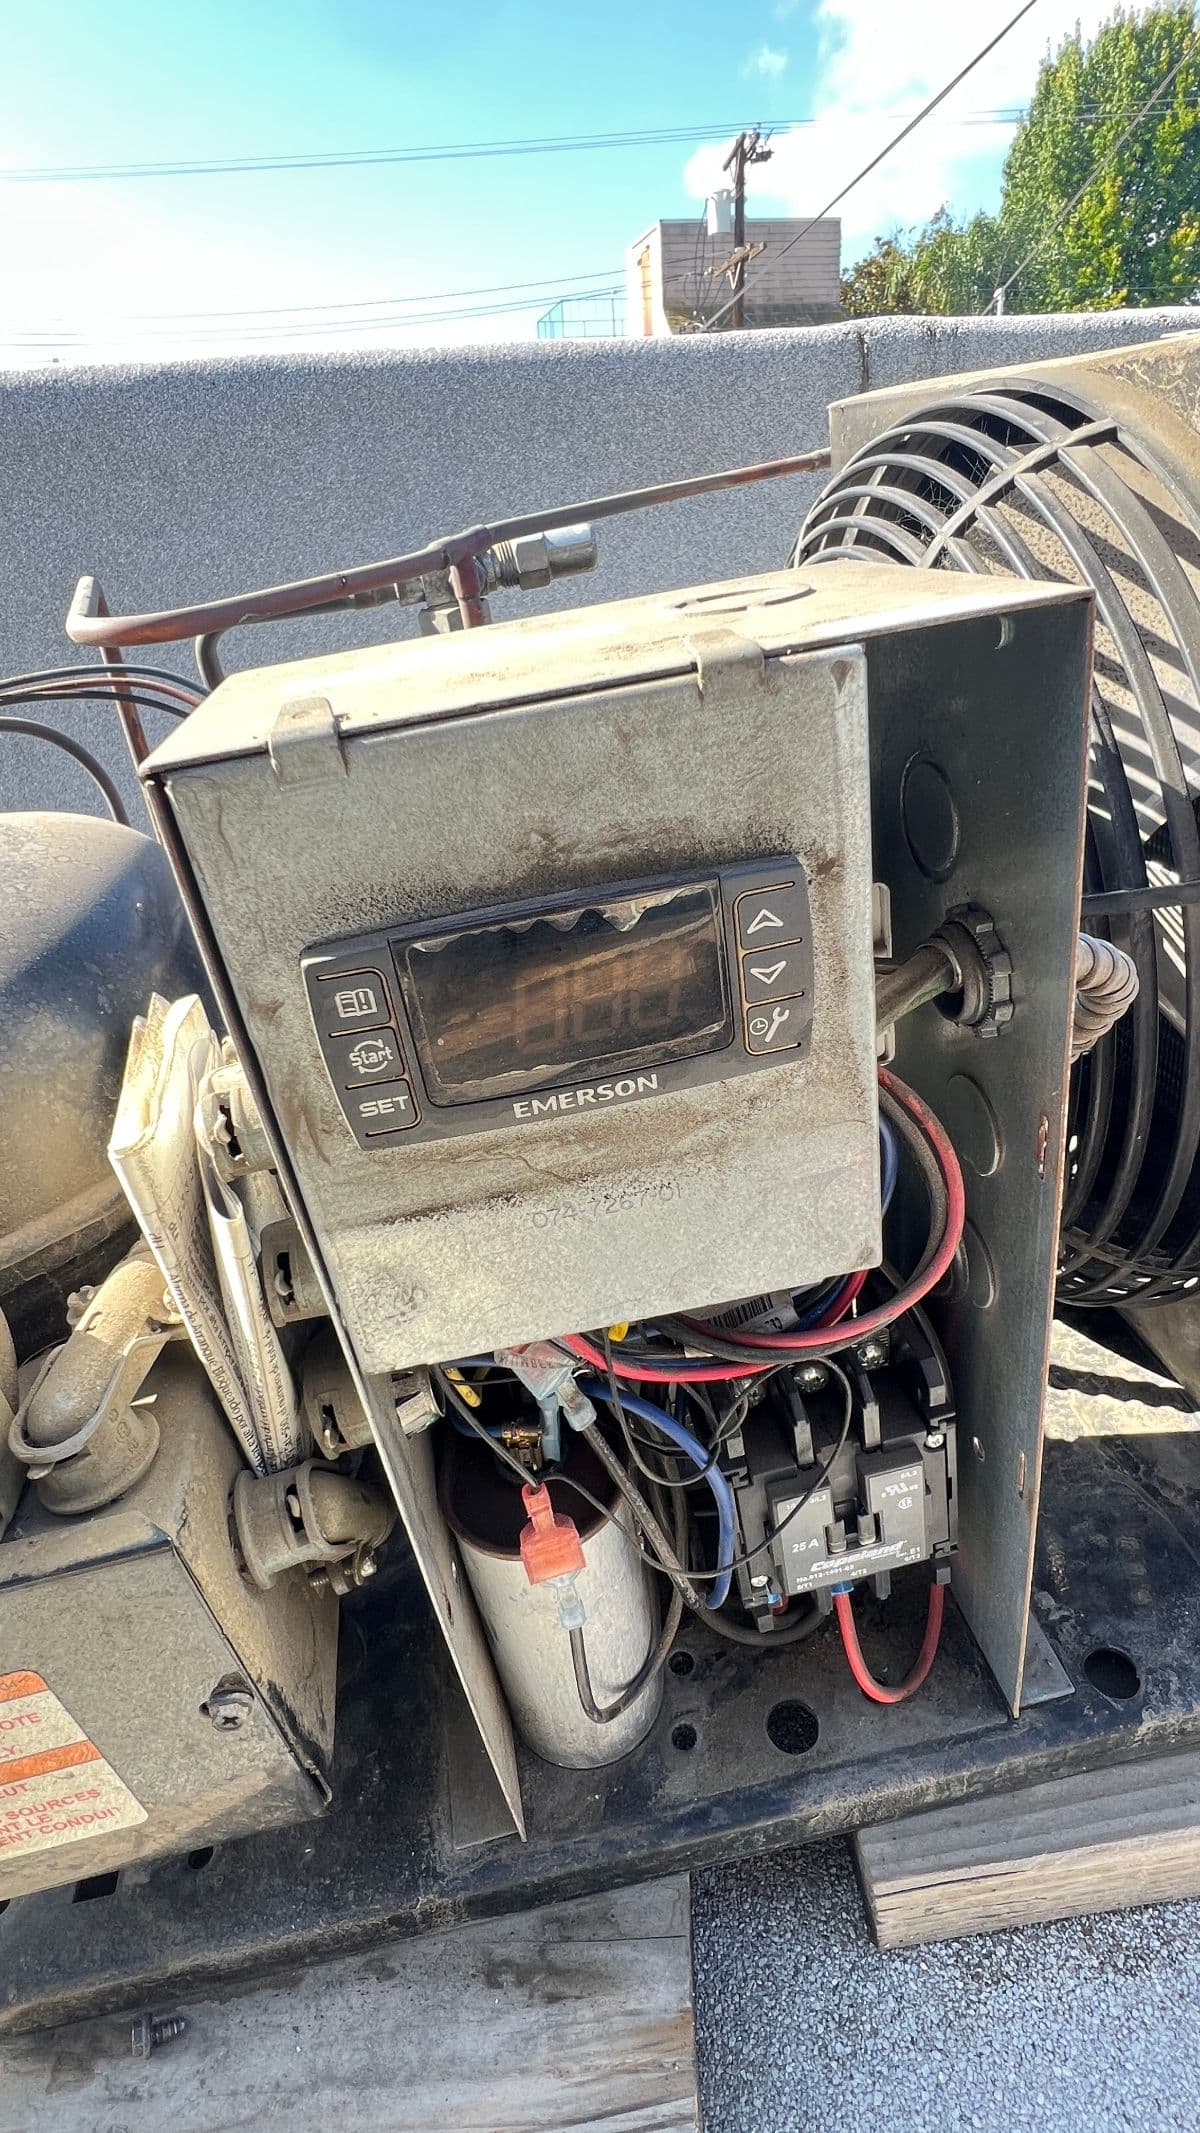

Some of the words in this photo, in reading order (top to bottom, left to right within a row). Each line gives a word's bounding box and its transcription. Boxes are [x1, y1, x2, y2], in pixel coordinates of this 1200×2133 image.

[349, 1046, 394, 1067] Start
[359, 1095, 409, 1118] SET
[512, 1074, 659, 1119] EMERSON
[212, 1366, 241, 1415] Bloqueado
[232, 1415, 248, 1430] por
[792, 1541, 806, 1553] 25
[808, 1538, 819, 1549] A
[811, 1541, 904, 1572] Copeland
[6, 1788, 101, 1820] SOURCES
[25, 1813, 53, 1828] LE
